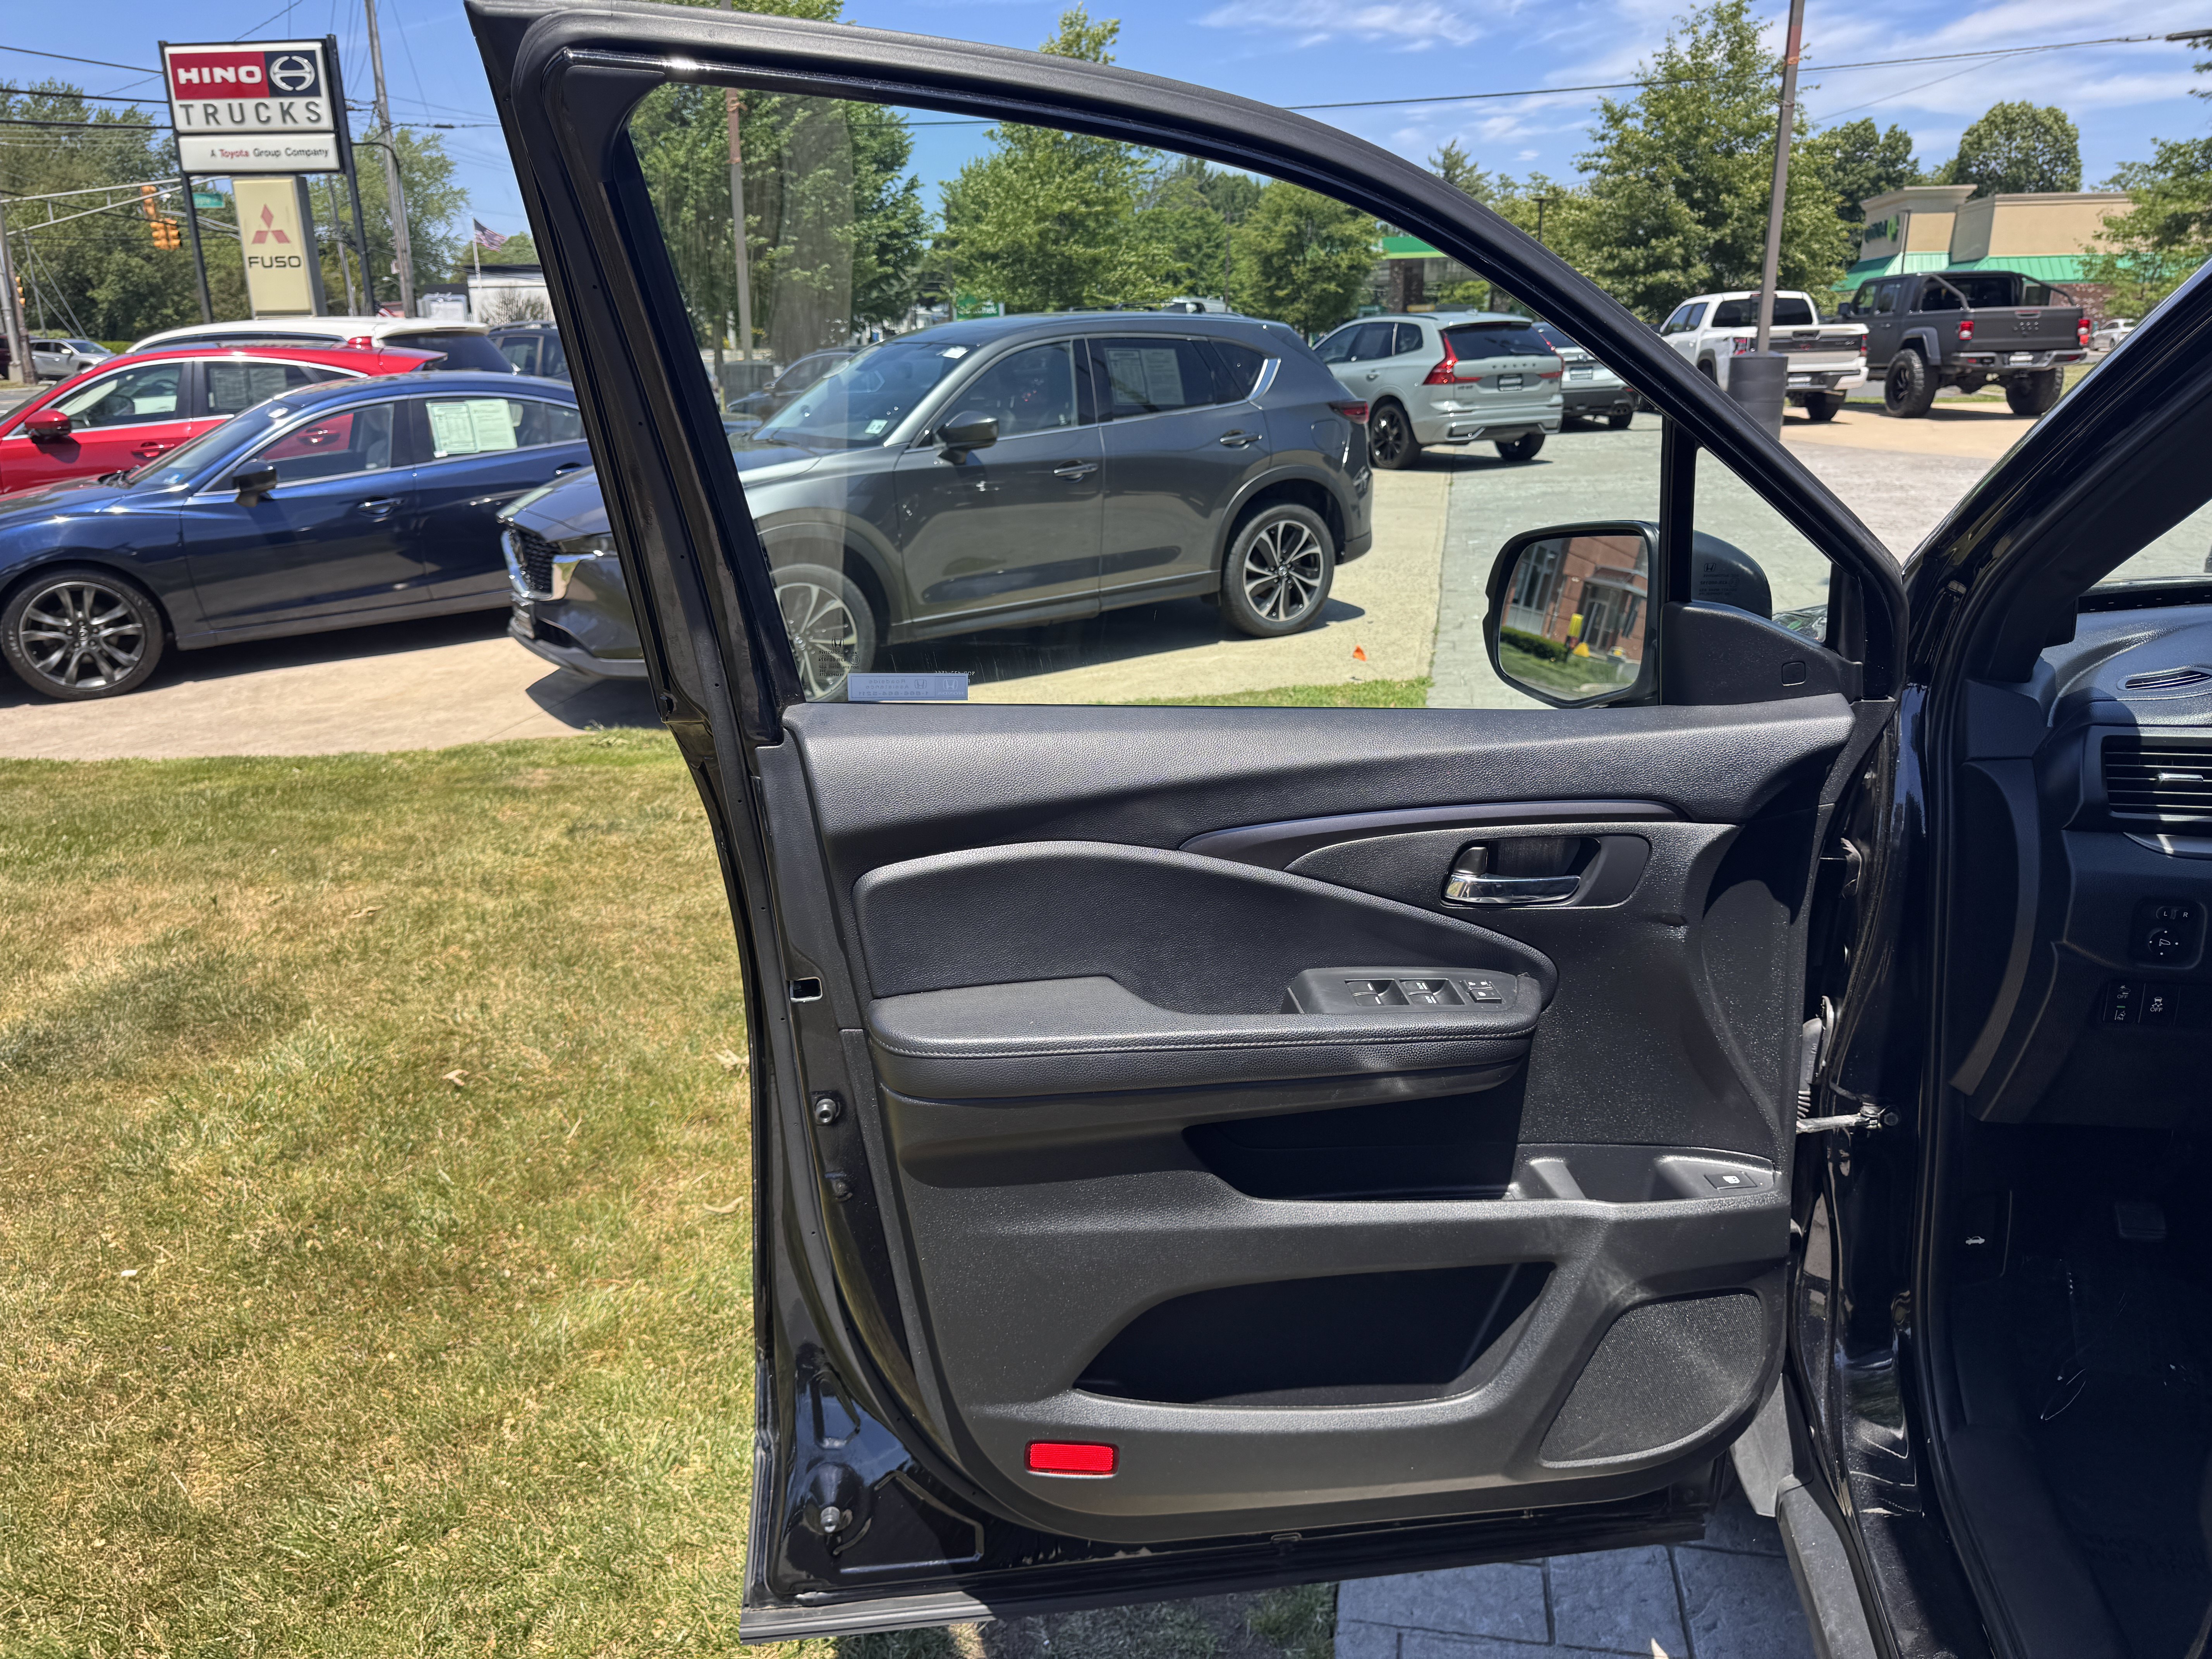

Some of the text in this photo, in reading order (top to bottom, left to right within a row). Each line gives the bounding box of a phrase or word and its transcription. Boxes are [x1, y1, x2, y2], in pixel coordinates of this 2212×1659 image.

[177, 65, 262, 84] HINO
[179, 102, 322, 126] TRUCKS
[219, 149, 249, 158] Toyota
[252, 148, 281, 158] Group
[285, 147, 329, 158] Company
[249, 256, 301, 268] FUSO
